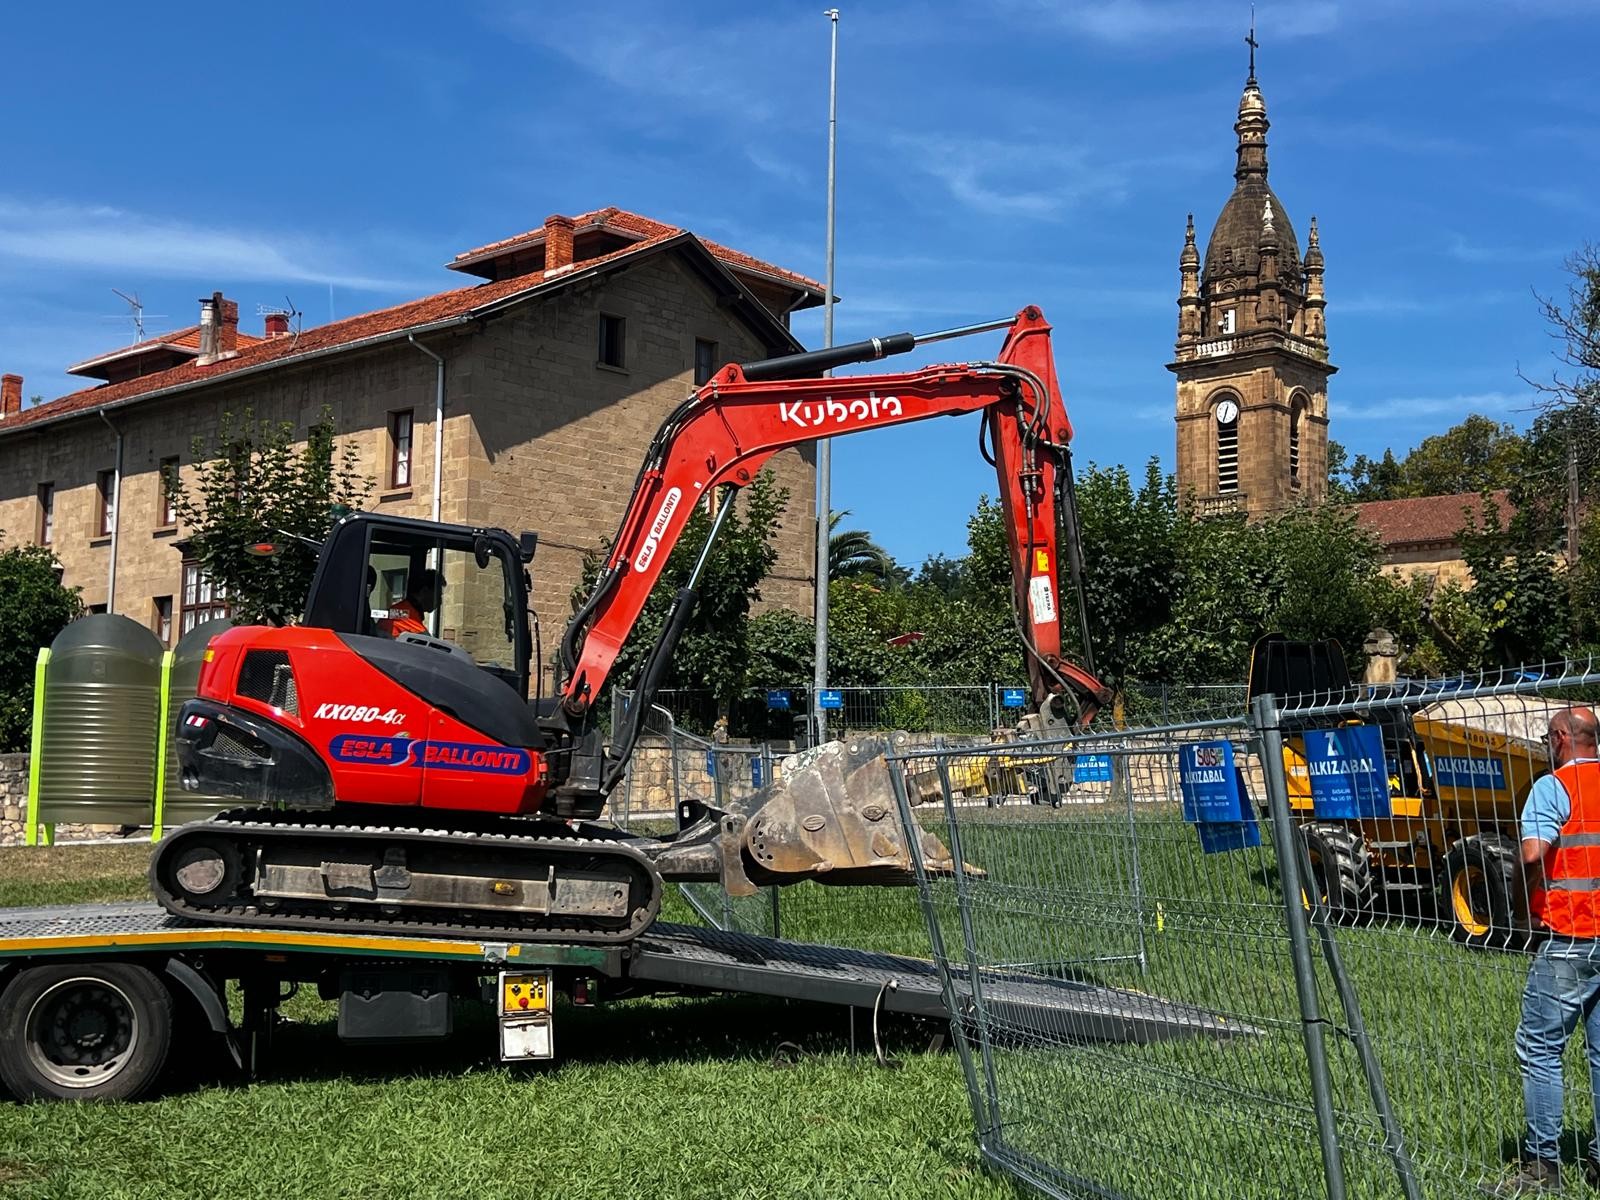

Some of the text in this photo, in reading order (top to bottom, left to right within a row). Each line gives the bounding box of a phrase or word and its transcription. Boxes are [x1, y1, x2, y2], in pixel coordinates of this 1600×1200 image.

[780, 392, 902, 427] Kubota
[638, 493, 678, 567] ESLA BALLONTI
[340, 740, 520, 769] ESLA BALLONTI
[1310, 758, 1377, 776] ALKIZABAL
[1437, 758, 1502, 776] ALKIZABAL
